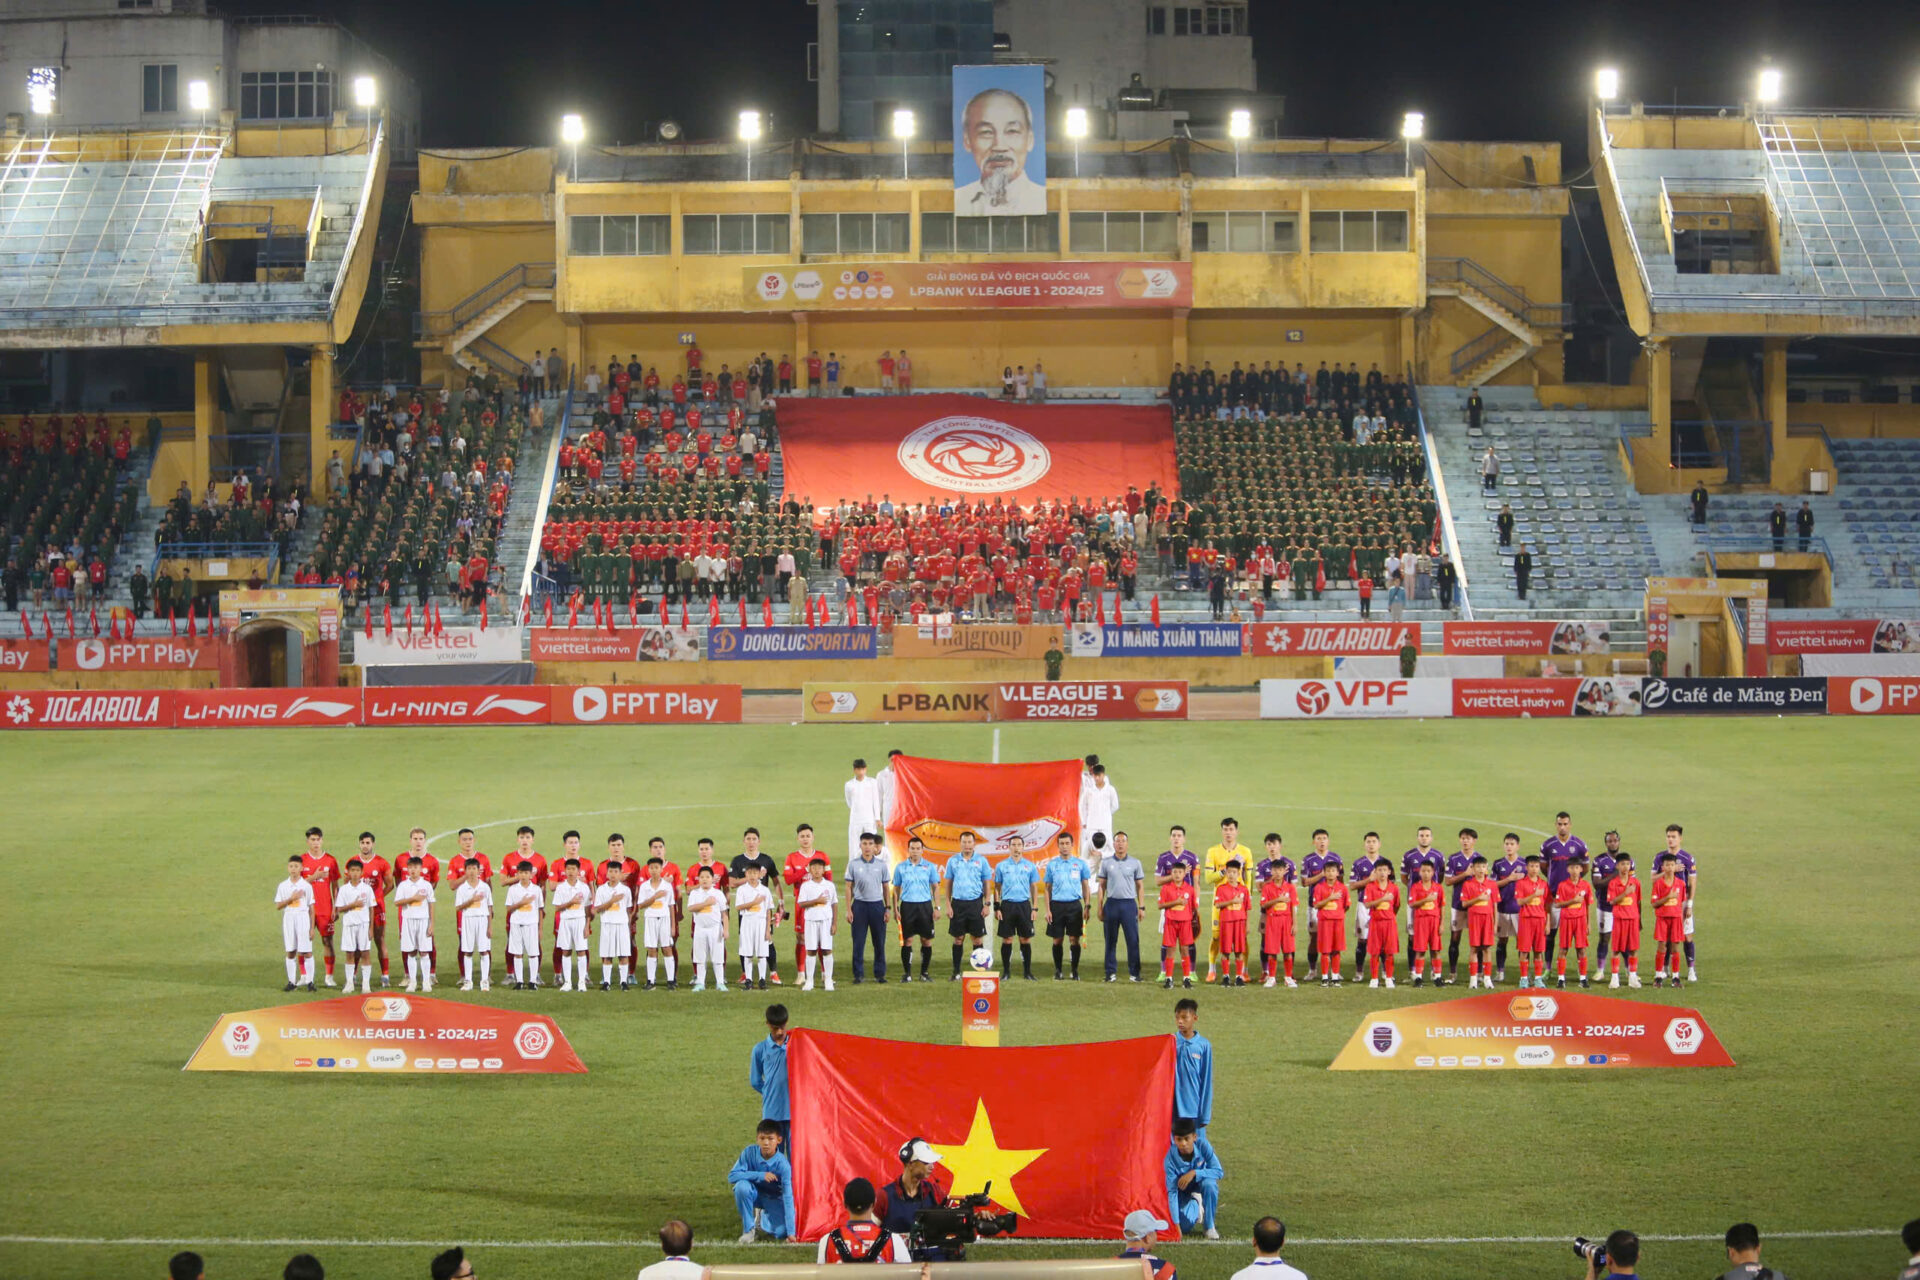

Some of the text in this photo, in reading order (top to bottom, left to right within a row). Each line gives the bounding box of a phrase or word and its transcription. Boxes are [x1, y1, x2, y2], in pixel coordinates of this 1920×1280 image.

[1072, 271, 1090, 281] GIA
[910, 286, 964, 297] LPBANK
[967, 286, 1031, 296] V.LEAGUE
[1034, 286, 1041, 296] 1
[1050, 286, 1104, 296] 2024/25
[681, 333, 693, 344] 11
[1288, 331, 1300, 341] 12
[397, 632, 477, 650] viettel
[742, 633, 871, 652] DONGLUCSPORT.VN
[1107, 631, 1119, 647] XI
[1163, 626, 1196, 647] XUÂN
[1200, 626, 1239, 647] THÀNH
[1297, 628, 1408, 651] JOGARBOLA
[1451, 636, 1502, 647] viettel
[1504, 638, 1530, 648] study
[1776, 635, 1828, 647] viettel
[1828, 637, 1853, 648] study
[110, 644, 199, 668] FPT Play
[437, 652, 477, 661] your way
[538, 642, 590, 654] viettel
[592, 645, 618, 655] study
[0, 646, 29, 670] lay
[1000, 685, 1124, 701] V.LEAGUE 1
[1334, 680, 1408, 706] VPF
[1672, 687, 1823, 705] Café de Măng Đen
[1888, 684, 1920, 706] FP
[40, 696, 160, 722] JOGARBOLA
[371, 701, 468, 717] LI-NING
[612, 692, 718, 720] FPT Play
[883, 694, 990, 711] LPBANK
[1462, 695, 1520, 708] viettel
[1522, 697, 1550, 709] study
[183, 704, 277, 719] LI-NING
[1026, 704, 1098, 717] 2024/25
[280, 1027, 340, 1039] LPBANK
[343, 1027, 416, 1039] V.LEAGUE
[418, 1028, 426, 1039] 1
[437, 1028, 498, 1040] 2024/25
[1425, 1026, 1488, 1038] LPBANK
[1490, 1026, 1563, 1037] V.LEAGUE
[1565, 1025, 1574, 1037] 1
[1585, 1025, 1645, 1037] 2024/25
